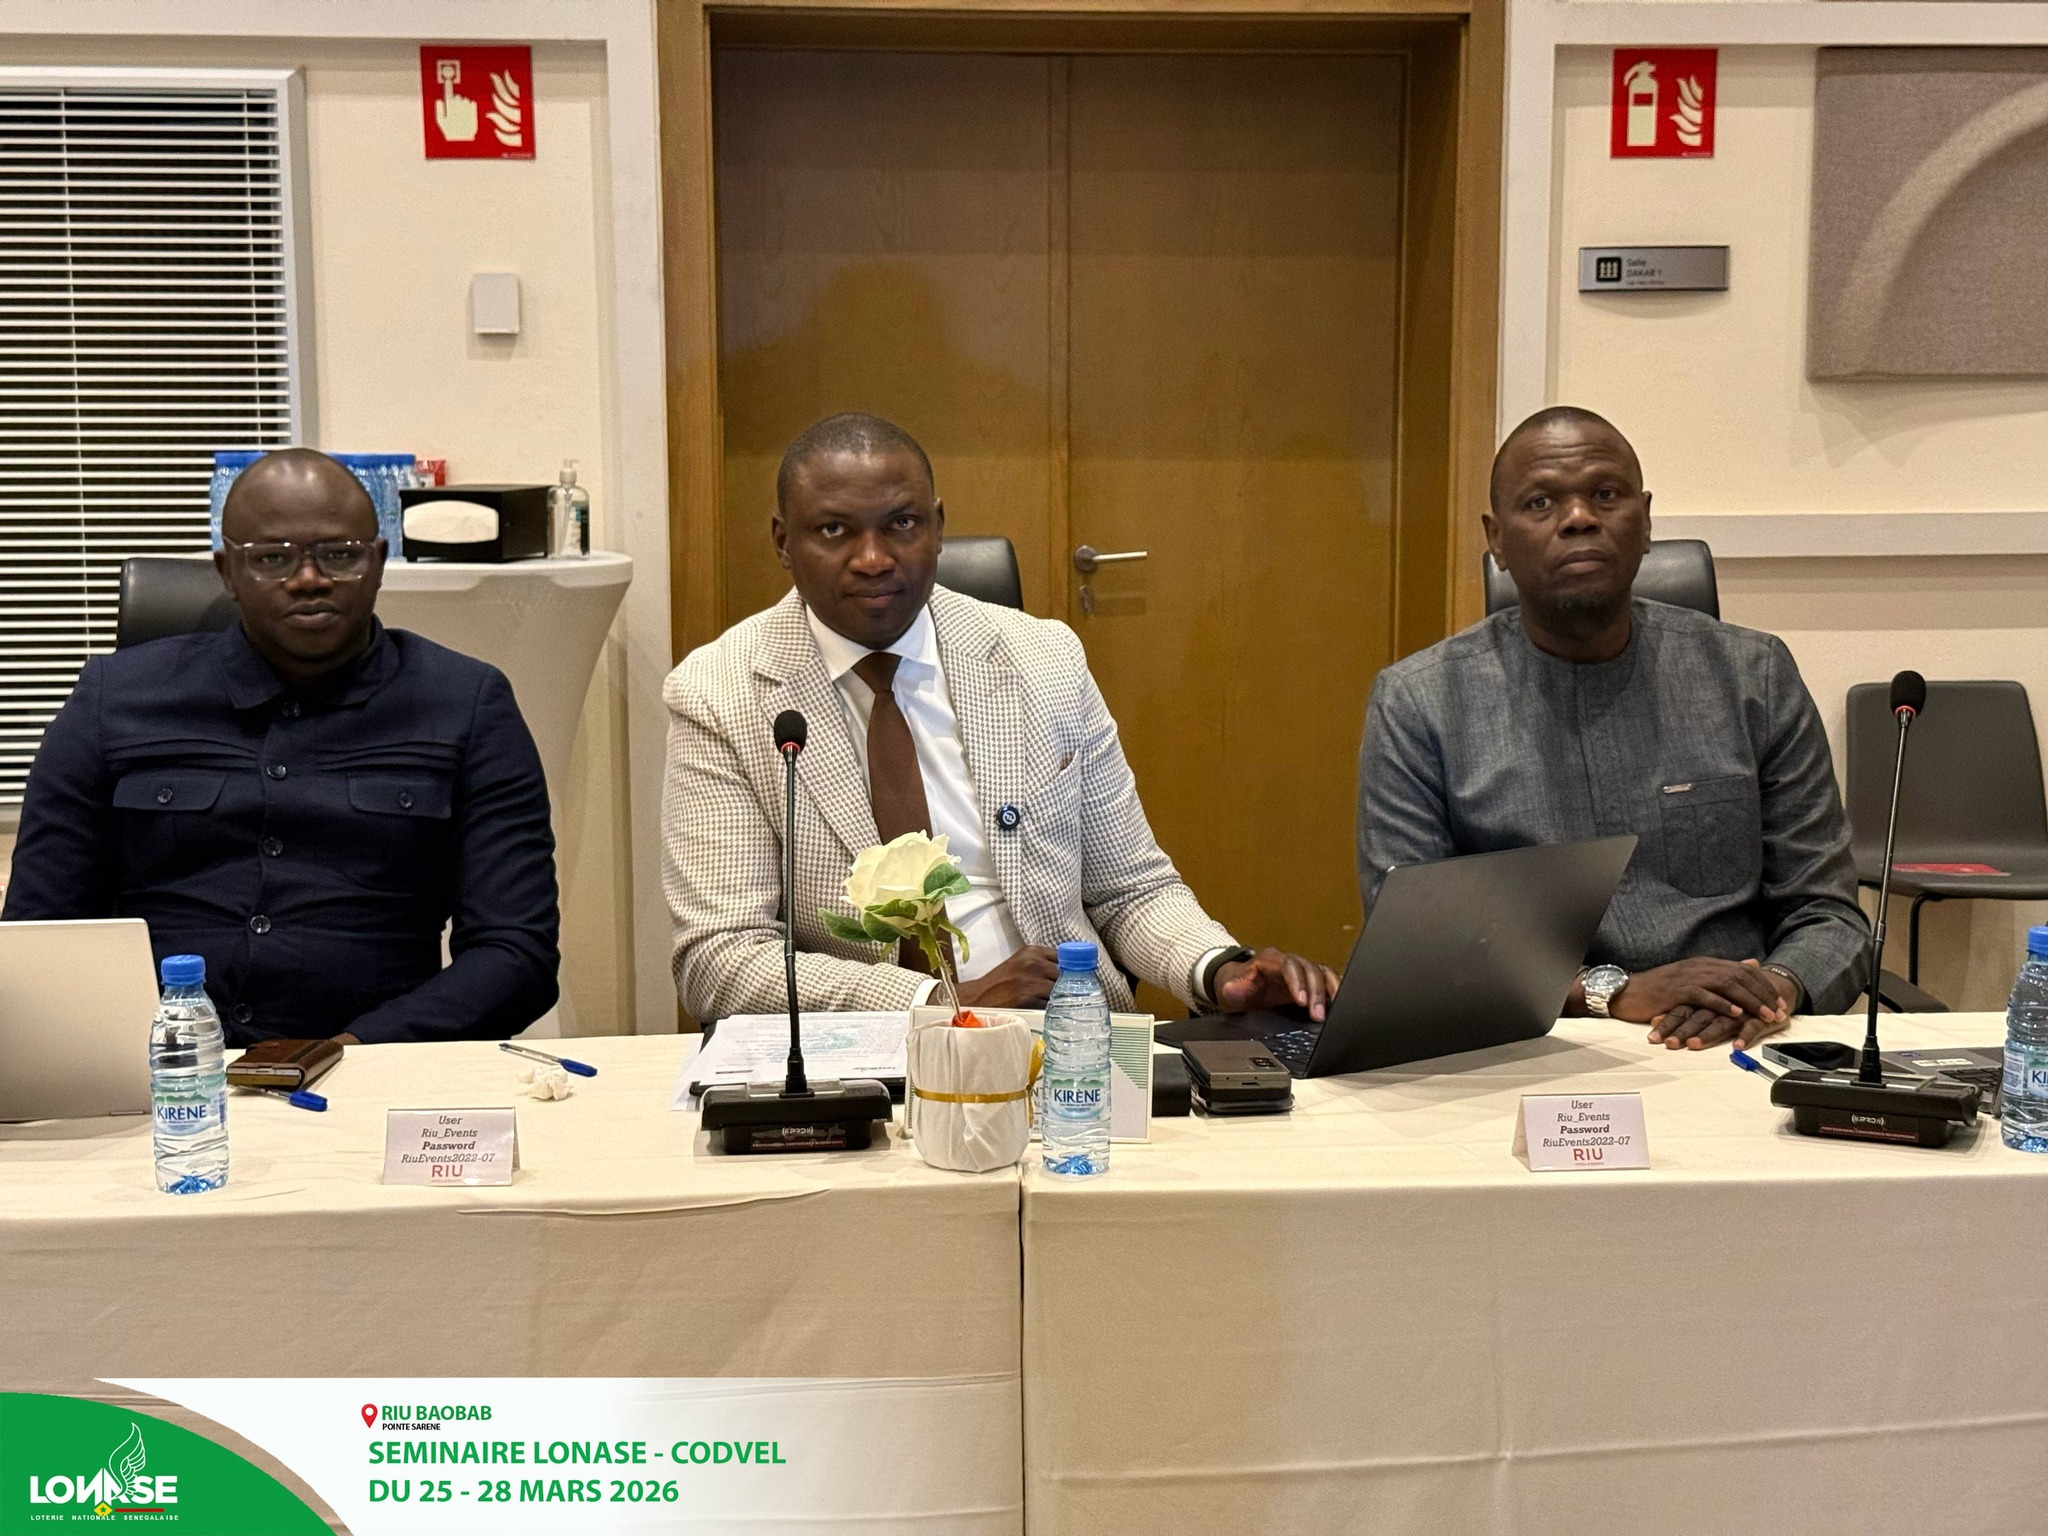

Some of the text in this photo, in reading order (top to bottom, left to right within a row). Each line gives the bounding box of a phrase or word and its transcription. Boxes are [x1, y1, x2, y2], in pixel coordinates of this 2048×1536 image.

[1053, 1088, 1101, 1104] KIRÈNE
[1571, 1100, 1594, 1110] User
[156, 1104, 208, 1120] KIRÈNE
[1557, 1112, 1611, 1123] Riu_Events
[438, 1115, 463, 1125] User
[421, 1127, 478, 1139] Riu_Events
[1560, 1124, 1610, 1135] Password
[421, 1141, 476, 1151] Password
[1542, 1136, 1631, 1148] RiuEvents2022-07
[400, 1153, 496, 1164] RiuEvents2022-07
[1573, 1148, 1604, 1161] RIU
[431, 1164, 464, 1178] RIU
